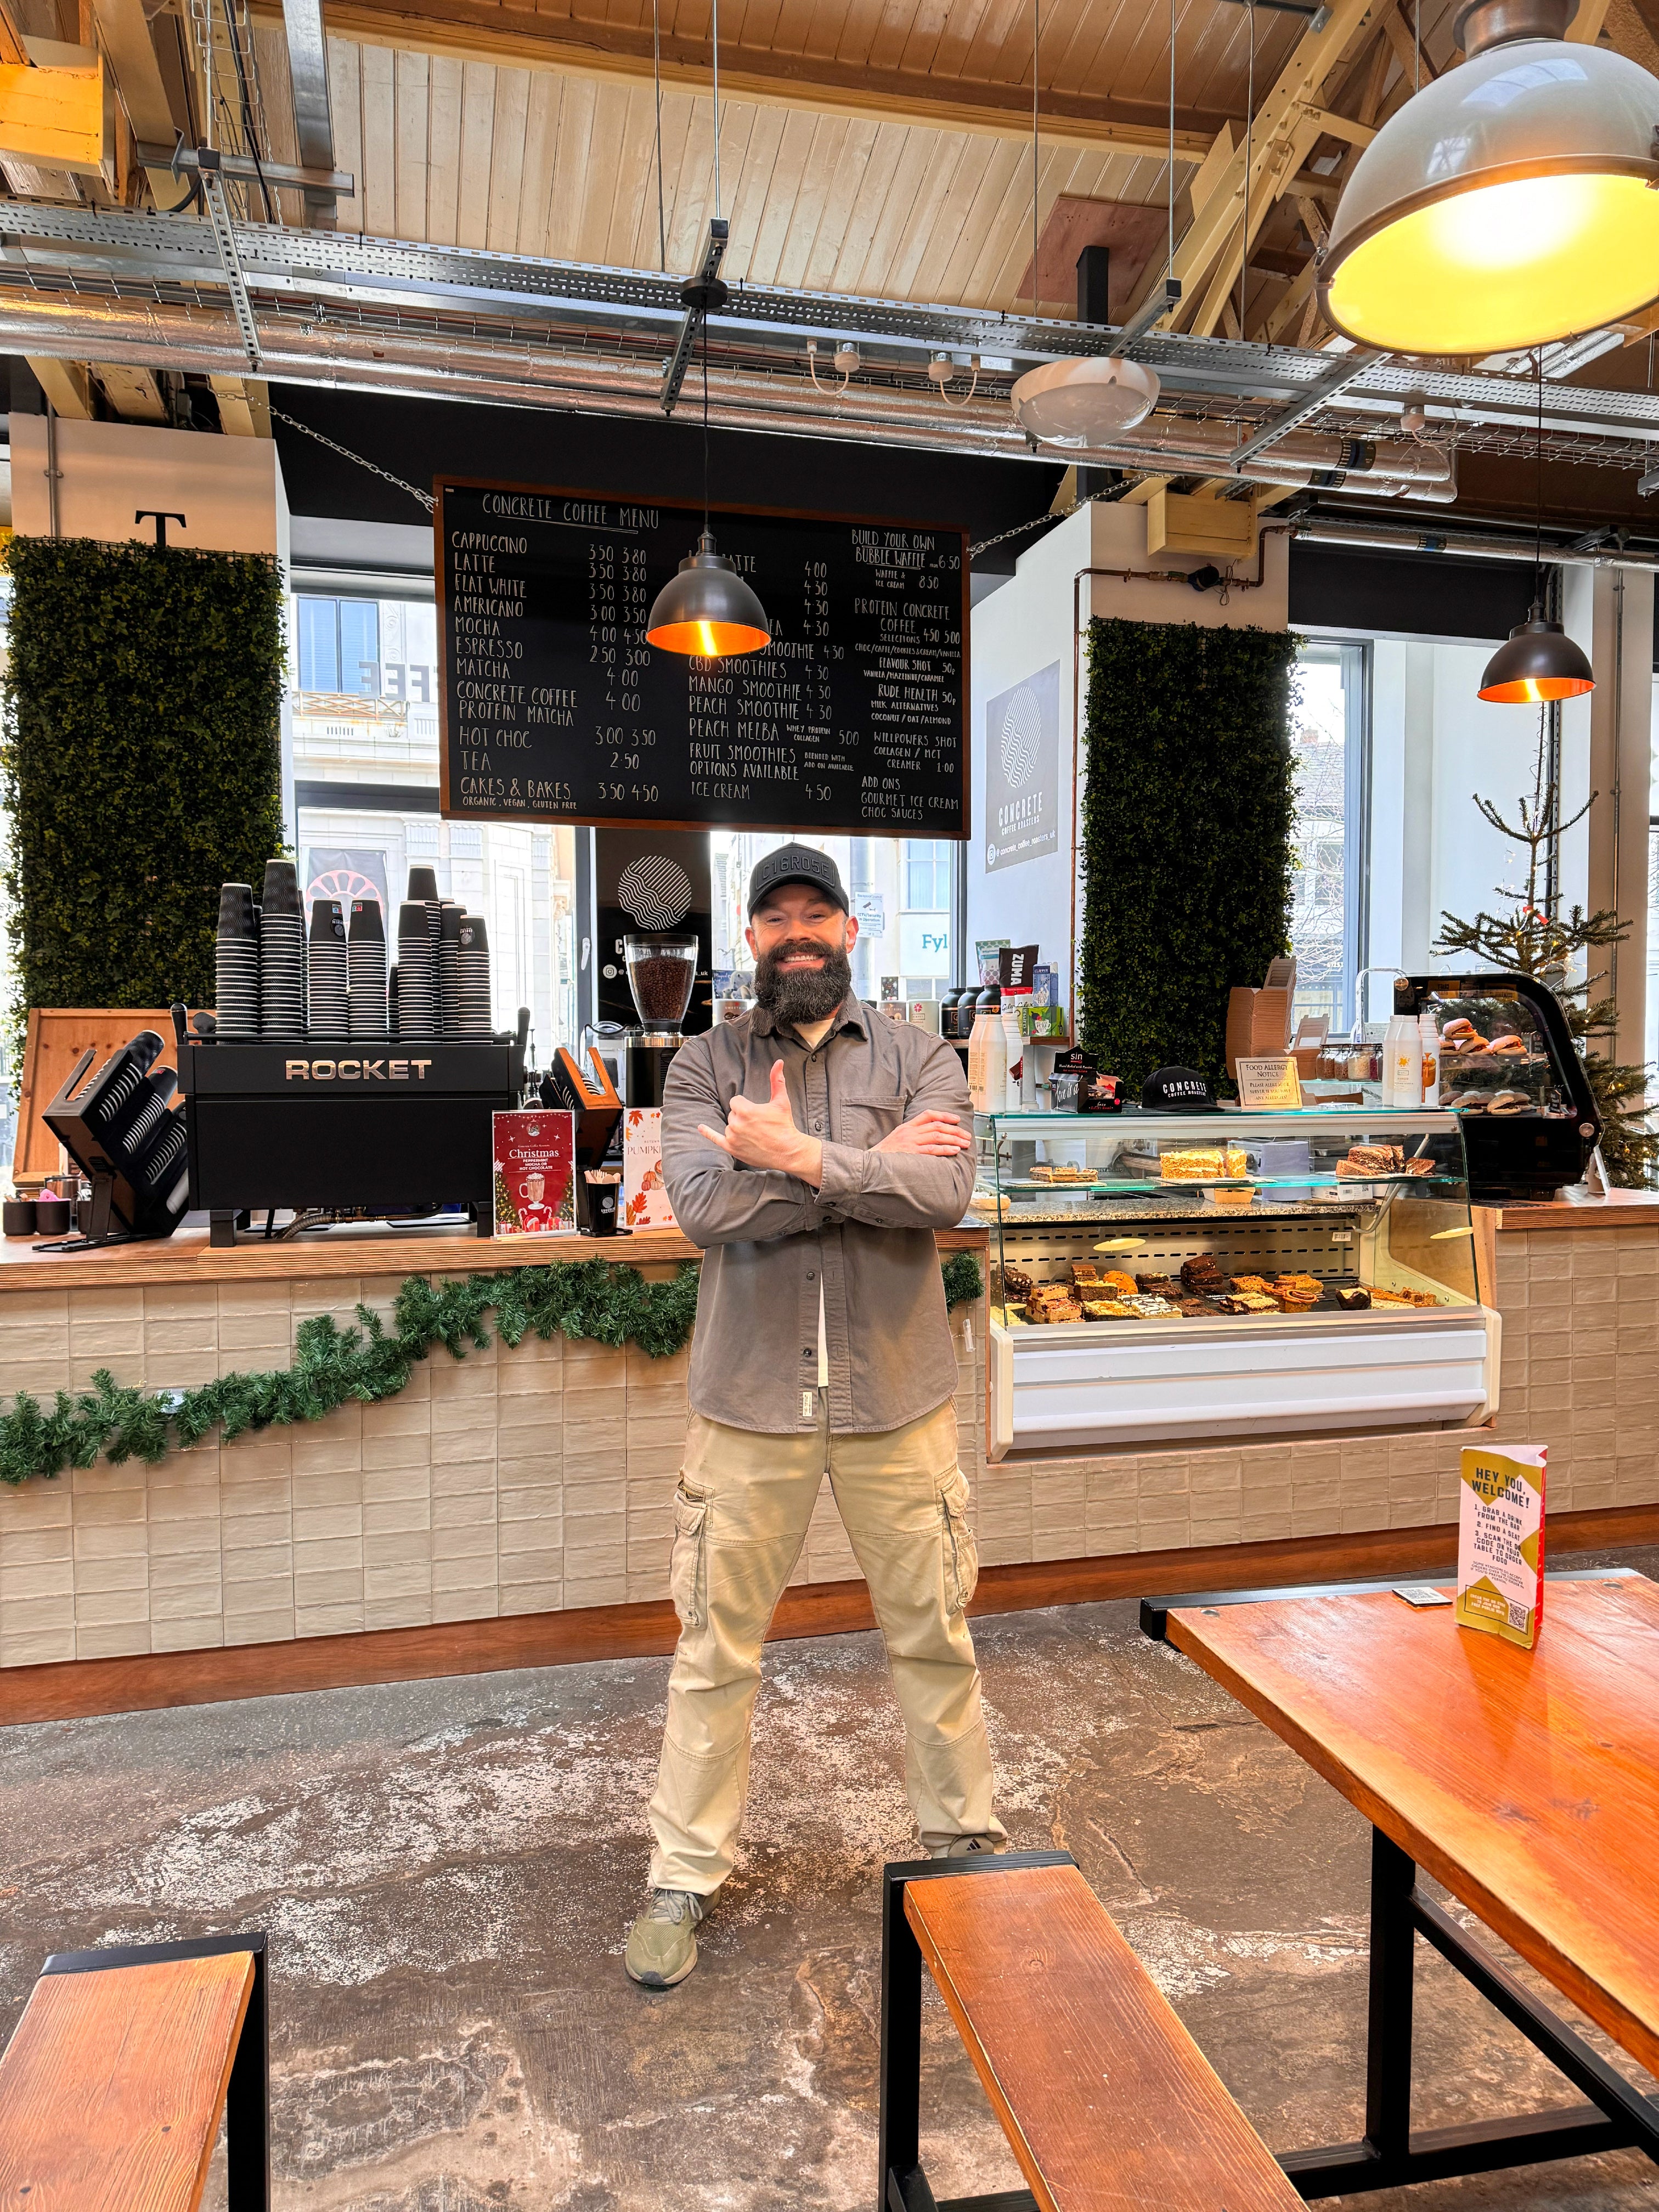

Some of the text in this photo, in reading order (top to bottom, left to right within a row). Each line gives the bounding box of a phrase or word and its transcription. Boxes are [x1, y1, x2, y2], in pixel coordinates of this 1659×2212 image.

[482, 493, 658, 529] CONCRETE COFFEE MENU
[452, 531, 527, 554] CAPPUCCINO
[851, 529, 935, 550] BUILD YOUR OWN
[454, 552, 495, 573] LATTE
[856, 546, 890, 565] BUBBLE
[894, 550, 926, 568] WAFFLE
[875, 568, 898, 579] WAFFLE
[455, 573, 483, 593] FLAT
[488, 578, 527, 598] WHITE
[887, 581, 905, 589] CREAM
[454, 595, 523, 617] AMERICANO
[855, 597, 950, 620] PROTEIN CONCRETE
[455, 616, 500, 636] MOCHA
[881, 618, 916, 634] COFFEE
[456, 636, 523, 659] ESPRESSO
[879, 633, 920, 644] SELECTIONS
[456, 657, 511, 679] MATCHA
[689, 655, 787, 679] CBD SMOOTHIES
[879, 657, 910, 670] FLAVOUR
[912, 659, 931, 672] SHOT
[456, 680, 578, 708] CONCRETE COFFEE
[689, 675, 802, 701] MANGO SMOOTHIE
[878, 684, 901, 698] RUDE
[904, 686, 938, 702] HEALTH
[459, 699, 574, 726] PROTEIN MATCHA
[689, 695, 799, 720] PEACH SMOOTHIE
[871, 700, 939, 712] MILK ALTERNATIVES
[871, 713, 900, 722] COCONUT
[460, 725, 532, 748] HOT CHOC
[689, 718, 780, 741] PEACH MELBA
[786, 724, 831, 735] WHEY PROTEIN
[793, 733, 820, 742] COLLAGEN
[874, 731, 957, 748] WILLPOWERS SHOT
[460, 750, 492, 771] TEA
[690, 742, 795, 763] FRUIT SMOOTHIES
[804, 752, 845, 762] BLENDED WITH
[873, 746, 941, 759] COLLAGEN MCT
[690, 760, 799, 781] OPTIONS AVAILABLE
[887, 759, 921, 770] CREAMER
[460, 776, 504, 795] CAKES
[528, 780, 571, 800] BAKES
[691, 781, 710, 797] ICE
[714, 783, 750, 800] CREAM
[861, 776, 900, 790] ADD ONS
[532, 800, 558, 809] GLUTEN
[562, 801, 577, 809] FREE
[861, 792, 958, 810] GOURMET ICE CREAM
[998, 792, 1042, 827] CONCRETE
[861, 806, 923, 820] CHOC SAUCES
[1002, 815, 1040, 836] COFFEE ROASTERS
[1011, 953, 1024, 986] ZUMA
[285, 1059, 432, 1080] ROCKET
[509, 1149, 559, 1158] Christmas
[1476, 1468, 1499, 1482] HEY
[1471, 1480, 1530, 1509] WELCOME!
[1477, 1511, 1520, 1531] FROM THE BAR
[1482, 1506, 1499, 1515] GRAB
[1508, 1514, 1522, 1526] DRINK
[1484, 1533, 1501, 1542] SCAN
[1503, 1538, 1513, 1547] THE
[1486, 1523, 1500, 1532] FIND
[1508, 1531, 1520, 1541] SEAT
[1474, 1543, 1493, 1554] TABLE
[1505, 1553, 1522, 1566] ORDER
[1476, 1537, 1520, 1557] CODE ON YOUR
[1492, 1555, 1508, 1565] FOOD
